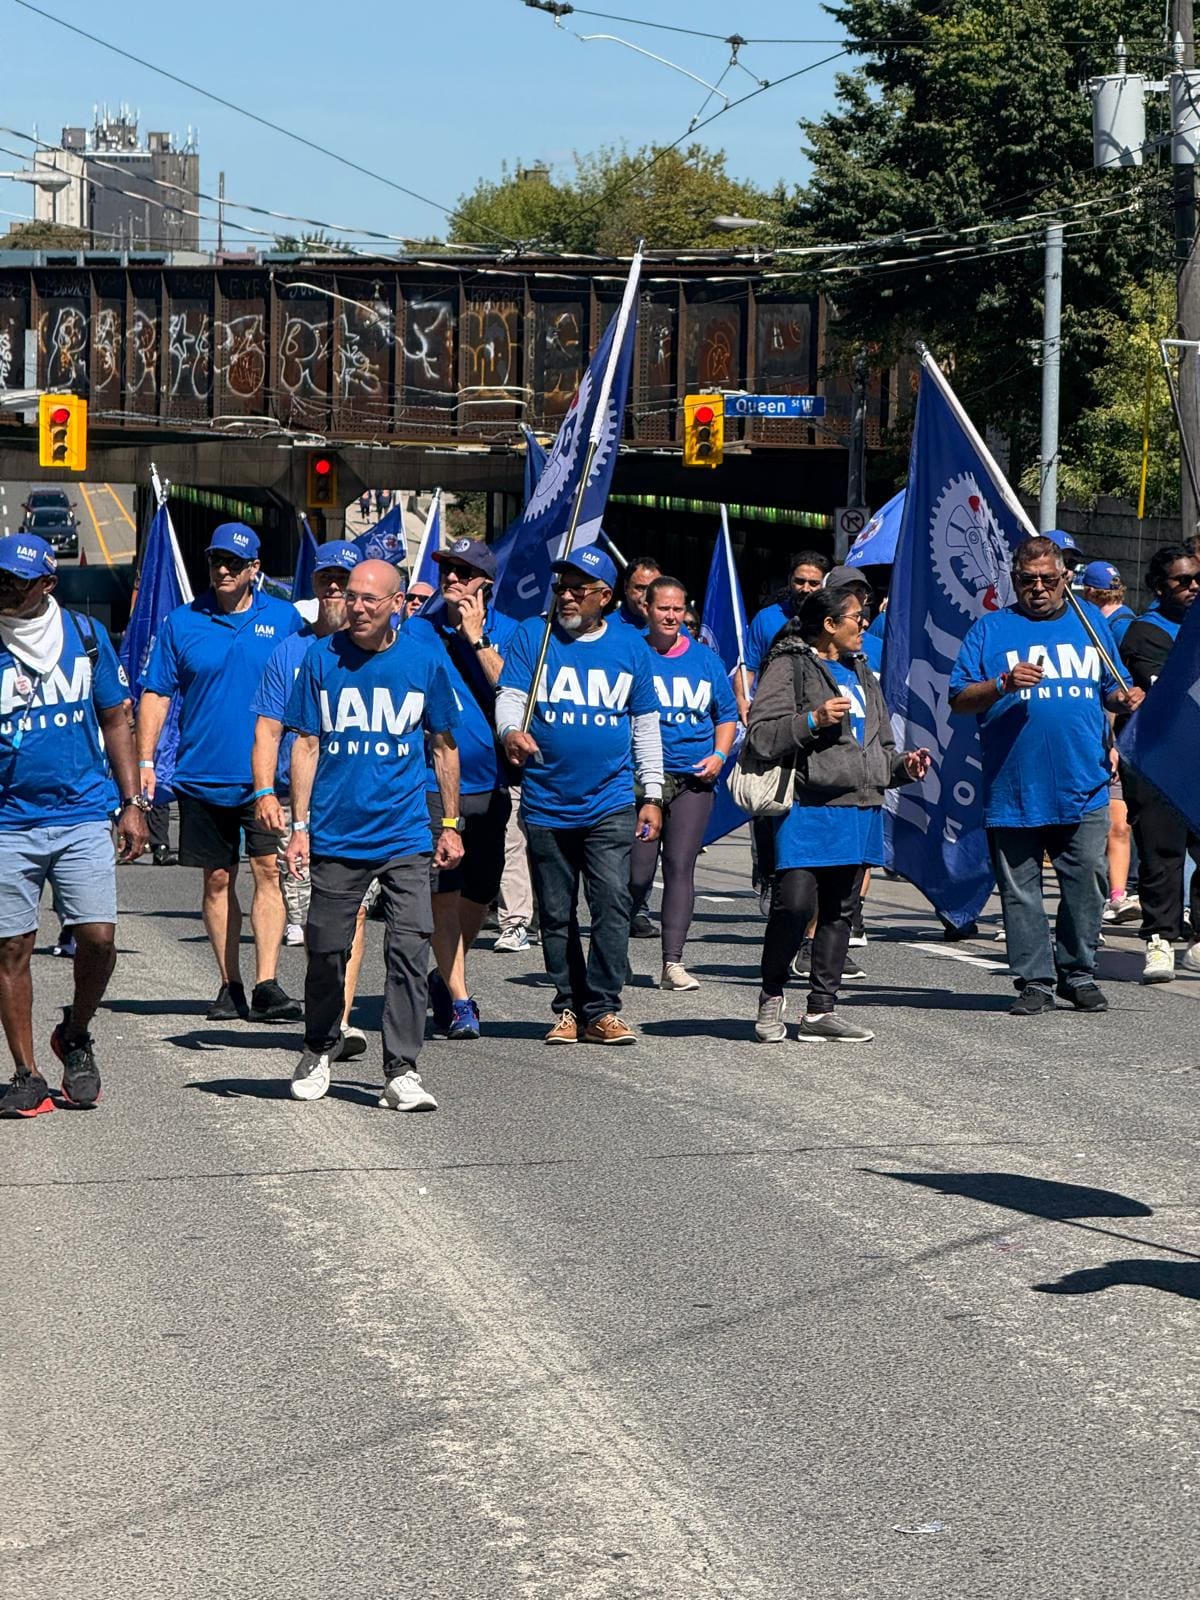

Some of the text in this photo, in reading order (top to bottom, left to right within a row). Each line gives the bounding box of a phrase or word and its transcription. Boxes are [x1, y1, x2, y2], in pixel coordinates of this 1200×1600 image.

[736, 399, 814, 413] Queen St W
[233, 533, 249, 545] IAM
[16, 545, 37, 559] IAM
[341, 548, 357, 560] IAM
[582, 552, 600, 564] IAM
[254, 623, 275, 636] IAM
[1006, 643, 1100, 683] IAM
[0, 656, 92, 715] AM
[536, 663, 633, 712] IAM
[1020, 685, 1094, 700] UNION
[320, 687, 425, 735] IAM
[544, 710, 618, 727] UNION
[0, 709, 84, 735] UNION
[328, 741, 410, 757] UNION
